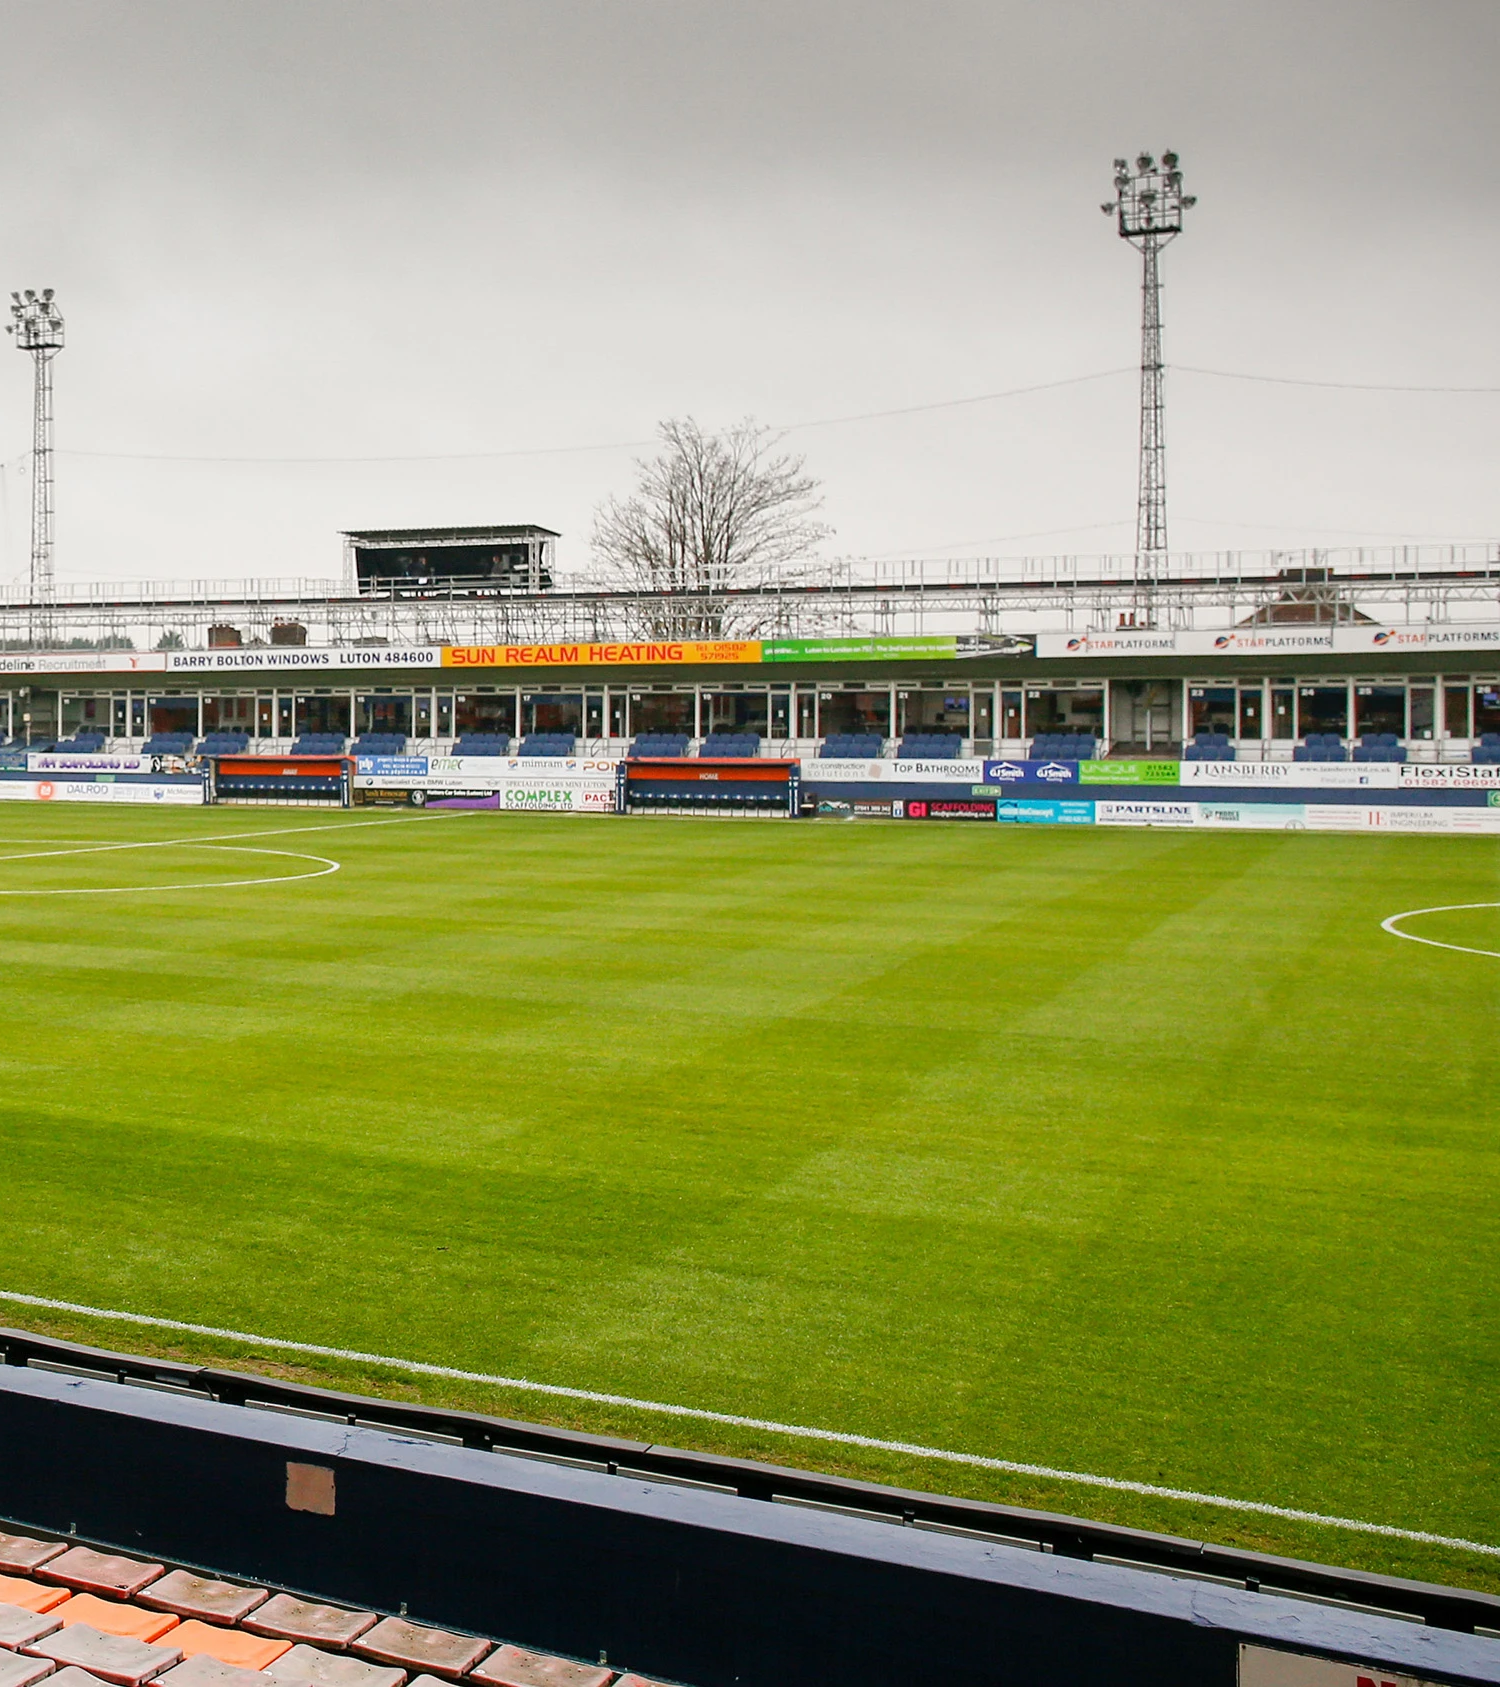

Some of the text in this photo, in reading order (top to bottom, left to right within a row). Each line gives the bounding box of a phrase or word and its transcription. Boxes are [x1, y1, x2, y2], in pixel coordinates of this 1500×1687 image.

[1237, 636, 1332, 648] STARPLATFORMS
[1397, 631, 1500, 645] STARPLATFORMS
[1088, 639, 1175, 649] STARPLATFORMS
[174, 651, 433, 667] BARRY BOLTON WINDOWS LUTON 484600
[451, 644, 683, 664] SUN REALM HEATING
[38, 657, 106, 670] Recruitment
[521, 759, 563, 768] mimram
[807, 770, 865, 778] solutions
[1206, 764, 1290, 777] LANSBERRY
[381, 779, 410, 787] Specialist
[1404, 778, 1448, 787] 01582
[67, 784, 109, 795] DALROD
[505, 790, 572, 802] COMPLEX
[505, 802, 556, 810] SCAFFOLDING
[908, 802, 927, 817] GI
[931, 802, 995, 813] SCAFFOLDING
[1116, 805, 1191, 815] PARTSLINE
